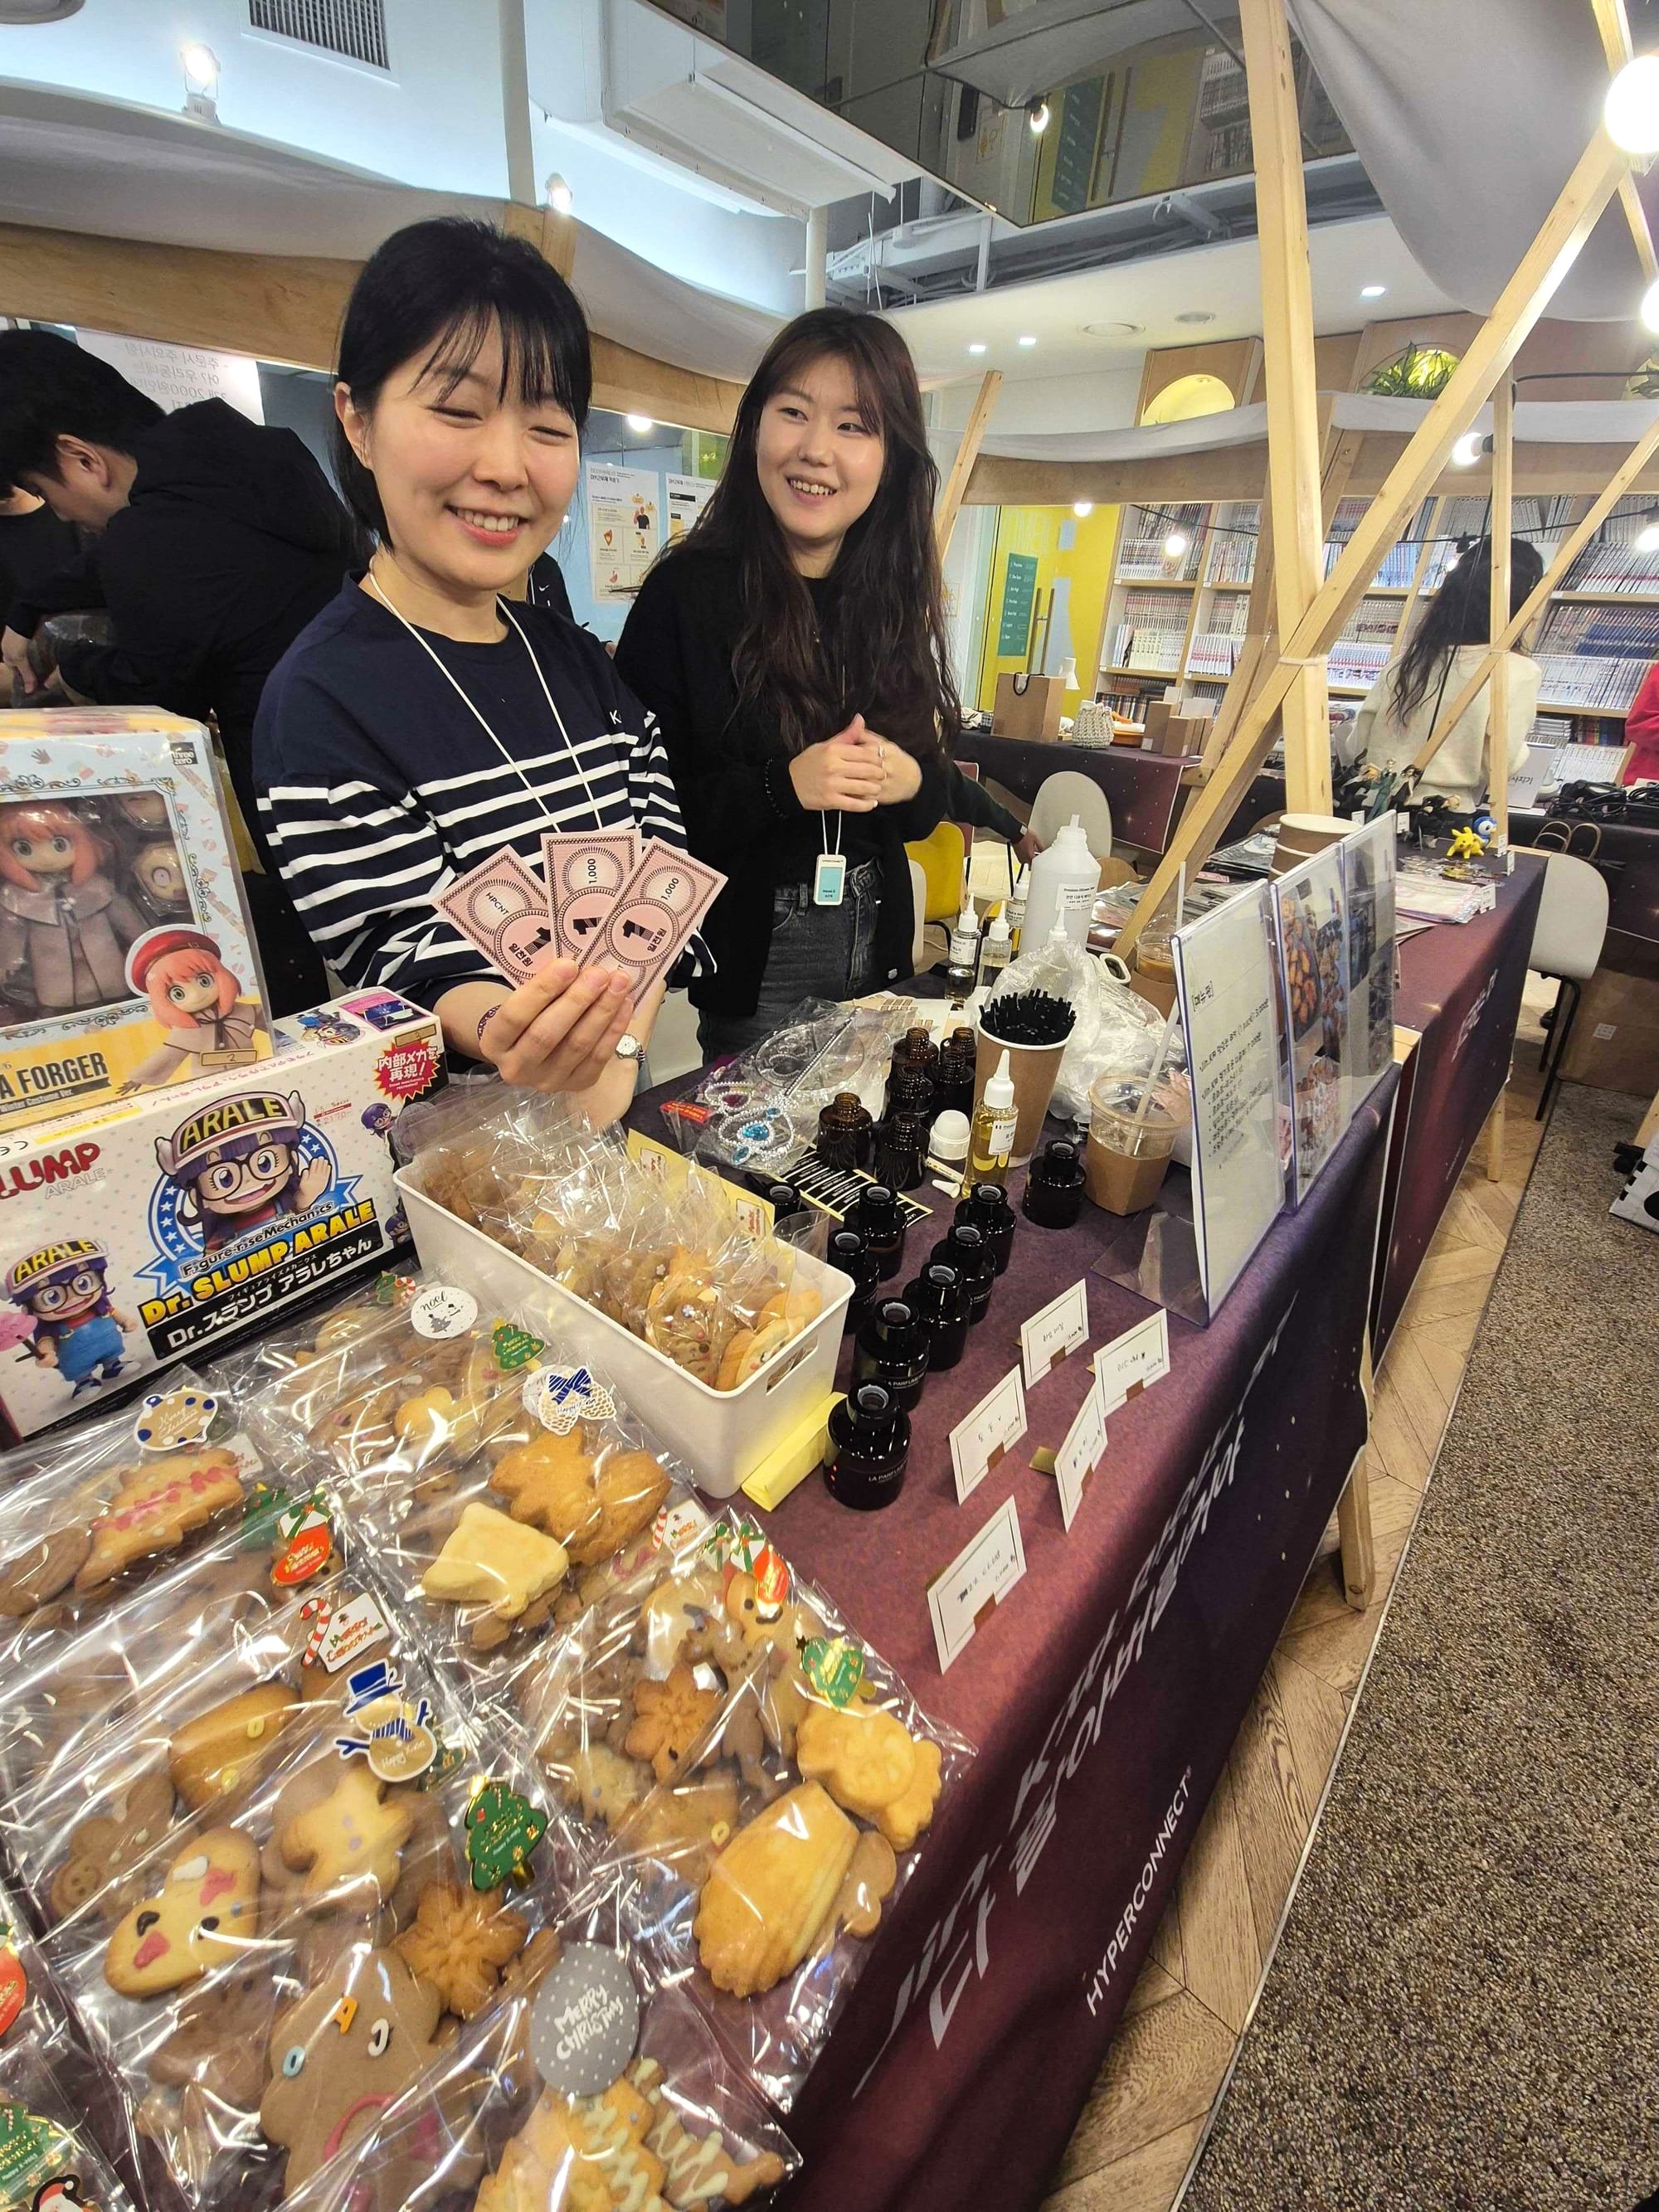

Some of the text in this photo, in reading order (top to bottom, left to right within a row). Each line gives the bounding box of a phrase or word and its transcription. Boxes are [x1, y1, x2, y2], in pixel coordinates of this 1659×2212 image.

[587, 858, 597, 884] 1,000
[484, 892, 509, 916] HPCNT
[660, 878, 680, 902] 1,000
[508, 942, 534, 967] 일천원
[647, 927, 668, 953] 일천원
[17, 1052, 109, 1095] FORGER
[378, 1045, 440, 1072] 内部メカを
[27, 1091, 61, 1104] Costume
[180, 1098, 285, 1151] ARALE
[45, 1167, 107, 1200] ARALE
[14, 1238, 97, 1282] ARALE
[140, 1201, 375, 1326] Dr. SLUMP ARALE
[278, 1238, 372, 1294] アラレちゃん
[1085, 1777, 1189, 2017] HYPERCONNECT
[929, 1884, 996, 2050] 다
